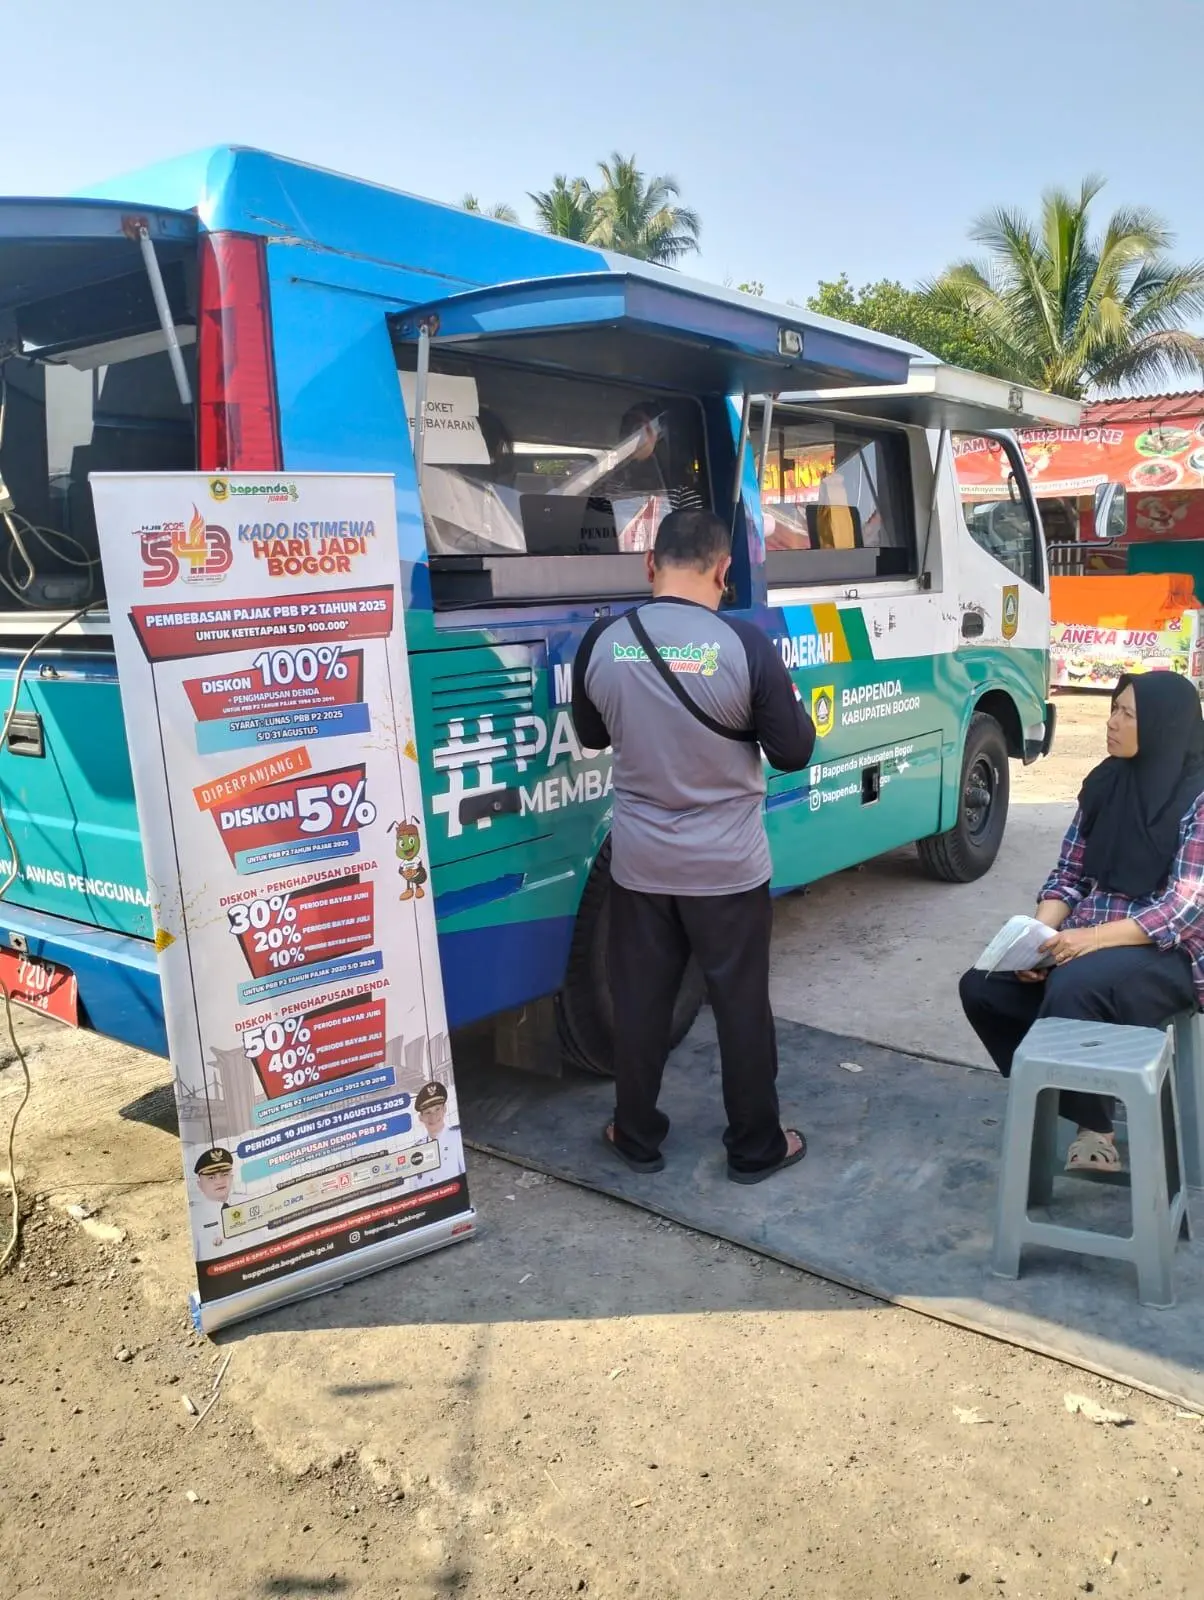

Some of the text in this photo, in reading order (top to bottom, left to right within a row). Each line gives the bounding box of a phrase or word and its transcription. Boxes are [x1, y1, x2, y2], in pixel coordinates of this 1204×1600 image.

[425, 401, 453, 413] OKET
[238, 520, 377, 542] KADO ISTIMEWA
[253, 537, 368, 559] HARI JADI
[267, 556, 352, 577] BOGOR
[146, 599, 388, 628] PEMBEBASAN PAJAK PBB P2 TAHUN 2025
[195, 629, 230, 642] UNTUK
[231, 625, 288, 640] KETETAPAN
[288, 623, 306, 635] S/D
[1060, 629, 1158, 647] ANEKA JUS
[782, 632, 834, 669] DAERAH
[201, 646, 349, 694] DISKON 100%
[233, 689, 290, 704] PENGHAPUSAN
[291, 686, 320, 699] DENDA
[842, 680, 902, 708] BAPPENDA
[230, 719, 259, 732] SYARAT
[265, 715, 290, 728] LUNAS
[293, 712, 310, 724] PBB
[311, 711, 322, 722] P2
[323, 709, 344, 721] 2025
[842, 696, 920, 726] KABUPATEN BOGOR
[257, 726, 319, 742] S/D 31 AGUSTUS
[822, 744, 914, 779] Bappenda Kabupaten Bogor
[201, 757, 294, 804] DIPERPANJANG
[220, 778, 377, 834] DISKON 5%
[246, 854, 268, 865] UNTUK
[26, 864, 67, 890] AWASI
[219, 888, 258, 907] DISKON
[267, 869, 342, 894] PENGHAPUSAN
[344, 860, 379, 878] DENDA
[227, 893, 298, 935] 30%
[300, 892, 370, 911] PERIODE BAYAR JUNI
[253, 924, 303, 953] 20%
[269, 946, 306, 968] 10%
[17, 959, 55, 993] 7207
[242, 984, 266, 998] UNTUK
[310, 968, 330, 981] PAJAK
[235, 1012, 272, 1032] DISKON
[281, 989, 355, 1017] PENGHAPUSAN
[356, 978, 391, 999] DENDA
[242, 1015, 312, 1060] 50%
[313, 1020, 342, 1032] PERIODE
[342, 1014, 365, 1027] BAYAR
[267, 1044, 317, 1073] 40%
[315, 1042, 344, 1054] PERIODE
[282, 1065, 321, 1090] 30%
[257, 1106, 281, 1119] UNTUK
[324, 1086, 344, 1099] PAJAK
[244, 1133, 282, 1154] PERIODE
[284, 1128, 297, 1140] 10
[296, 1121, 317, 1137] JUNI
[316, 1116, 332, 1131] S/D
[332, 1113, 344, 1126] 31
[343, 1103, 383, 1123] AGUSTUS
[383, 1097, 405, 1112] 2025
[268, 1140, 330, 1168] PENGHAPUSAN
[330, 1131, 358, 1150] DENDA
[359, 1127, 376, 1141] PBB
[376, 1122, 389, 1135] P2
